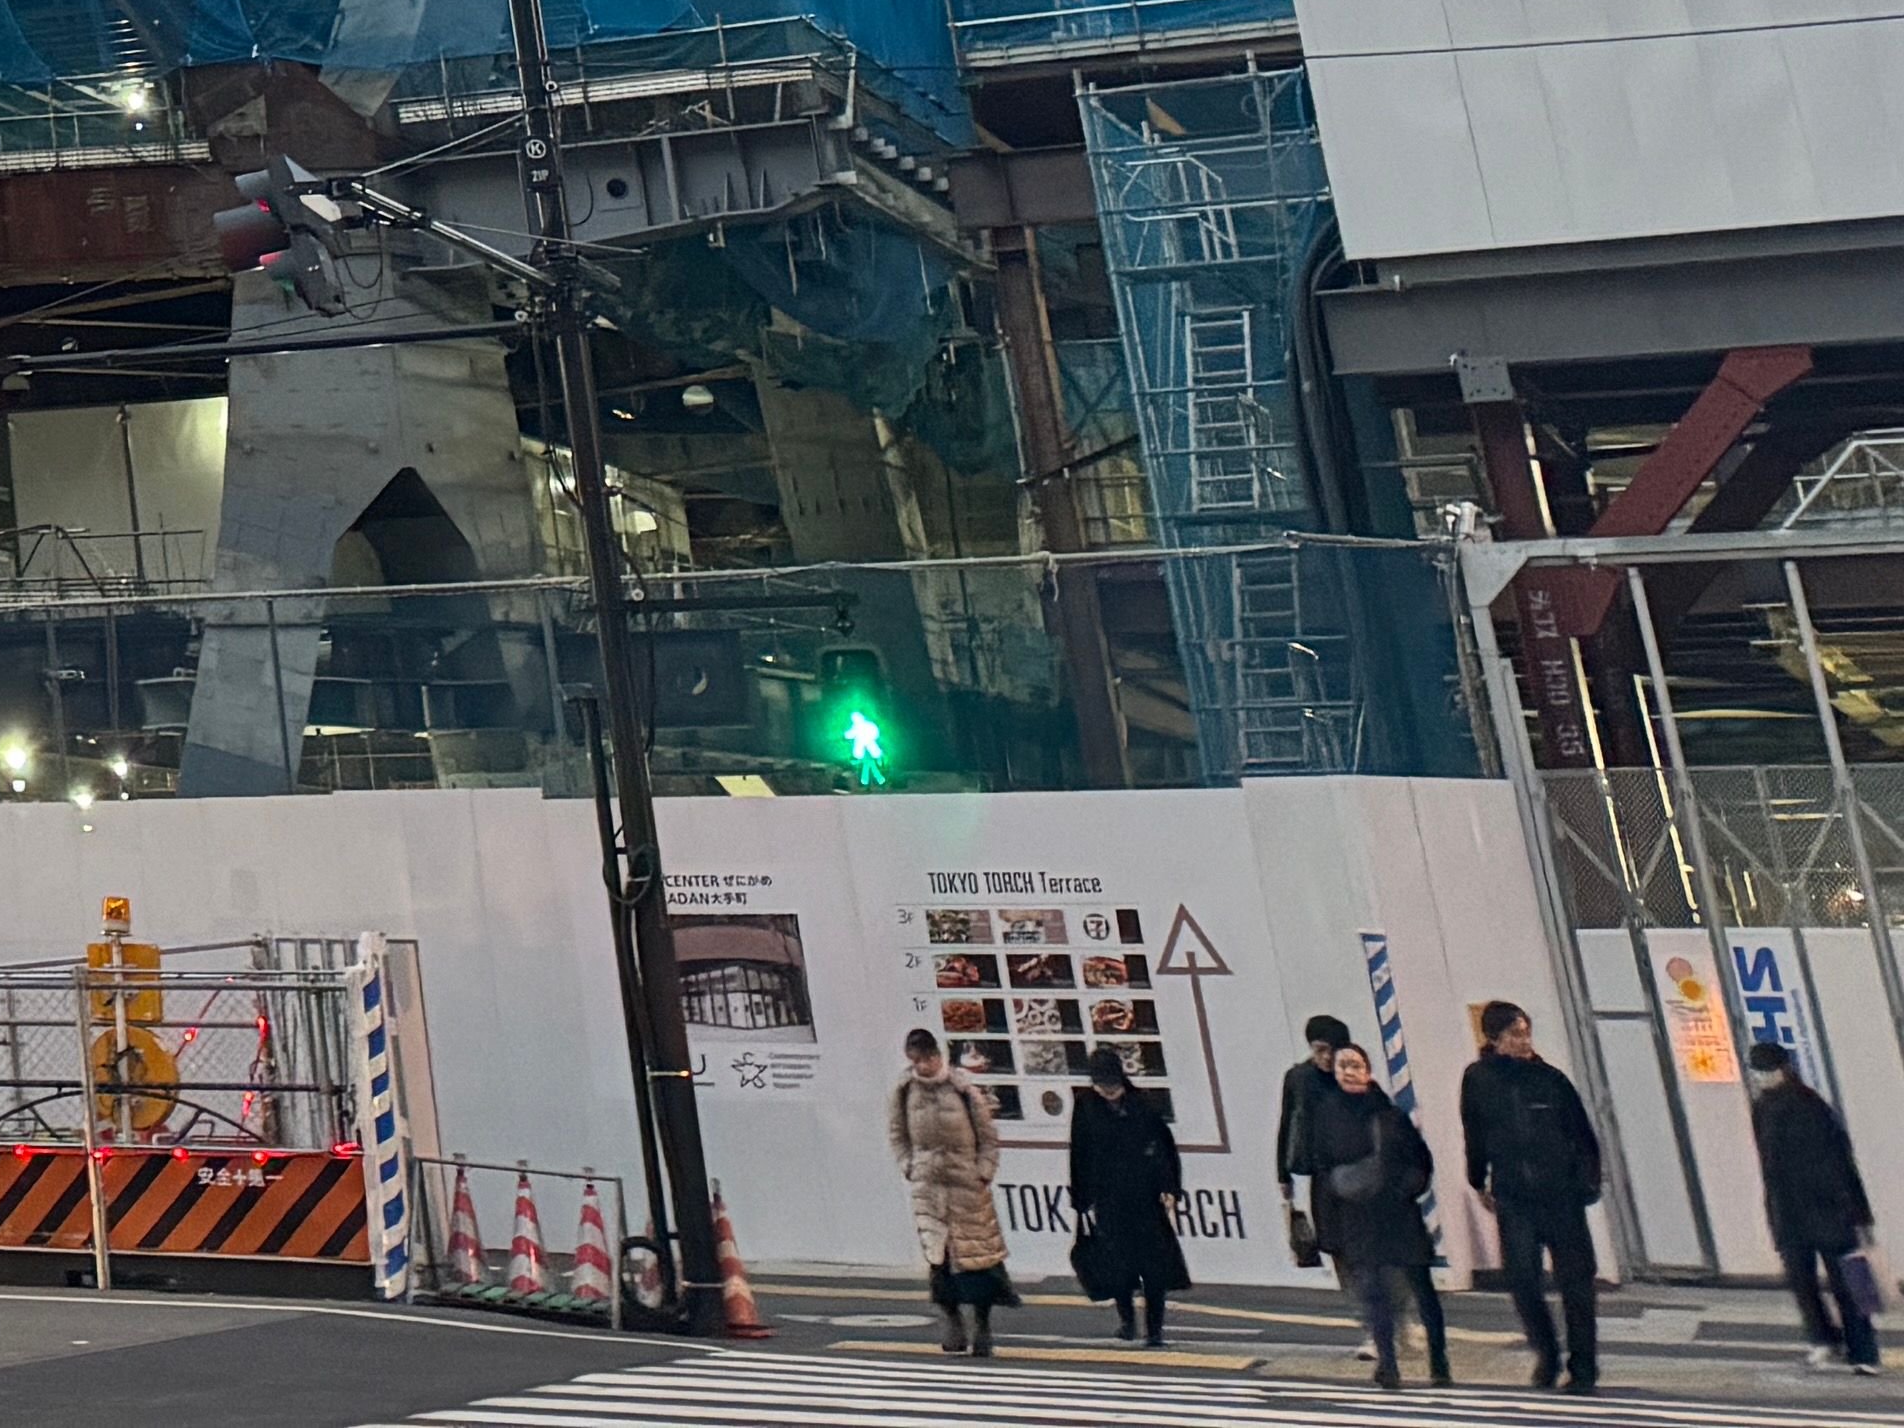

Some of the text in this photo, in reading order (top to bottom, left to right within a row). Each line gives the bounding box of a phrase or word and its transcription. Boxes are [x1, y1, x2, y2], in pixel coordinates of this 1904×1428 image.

[665, 874, 720, 888] CENTER
[927, 871, 1103, 894] TOKYO TORCH Terrace
[667, 892, 748, 905] ADAN大手町
[897, 909, 914, 925] 3F
[904, 952, 922, 968] 2F
[912, 997, 928, 1012] 1F
[997, 1183, 1247, 1240] TOK RCH
